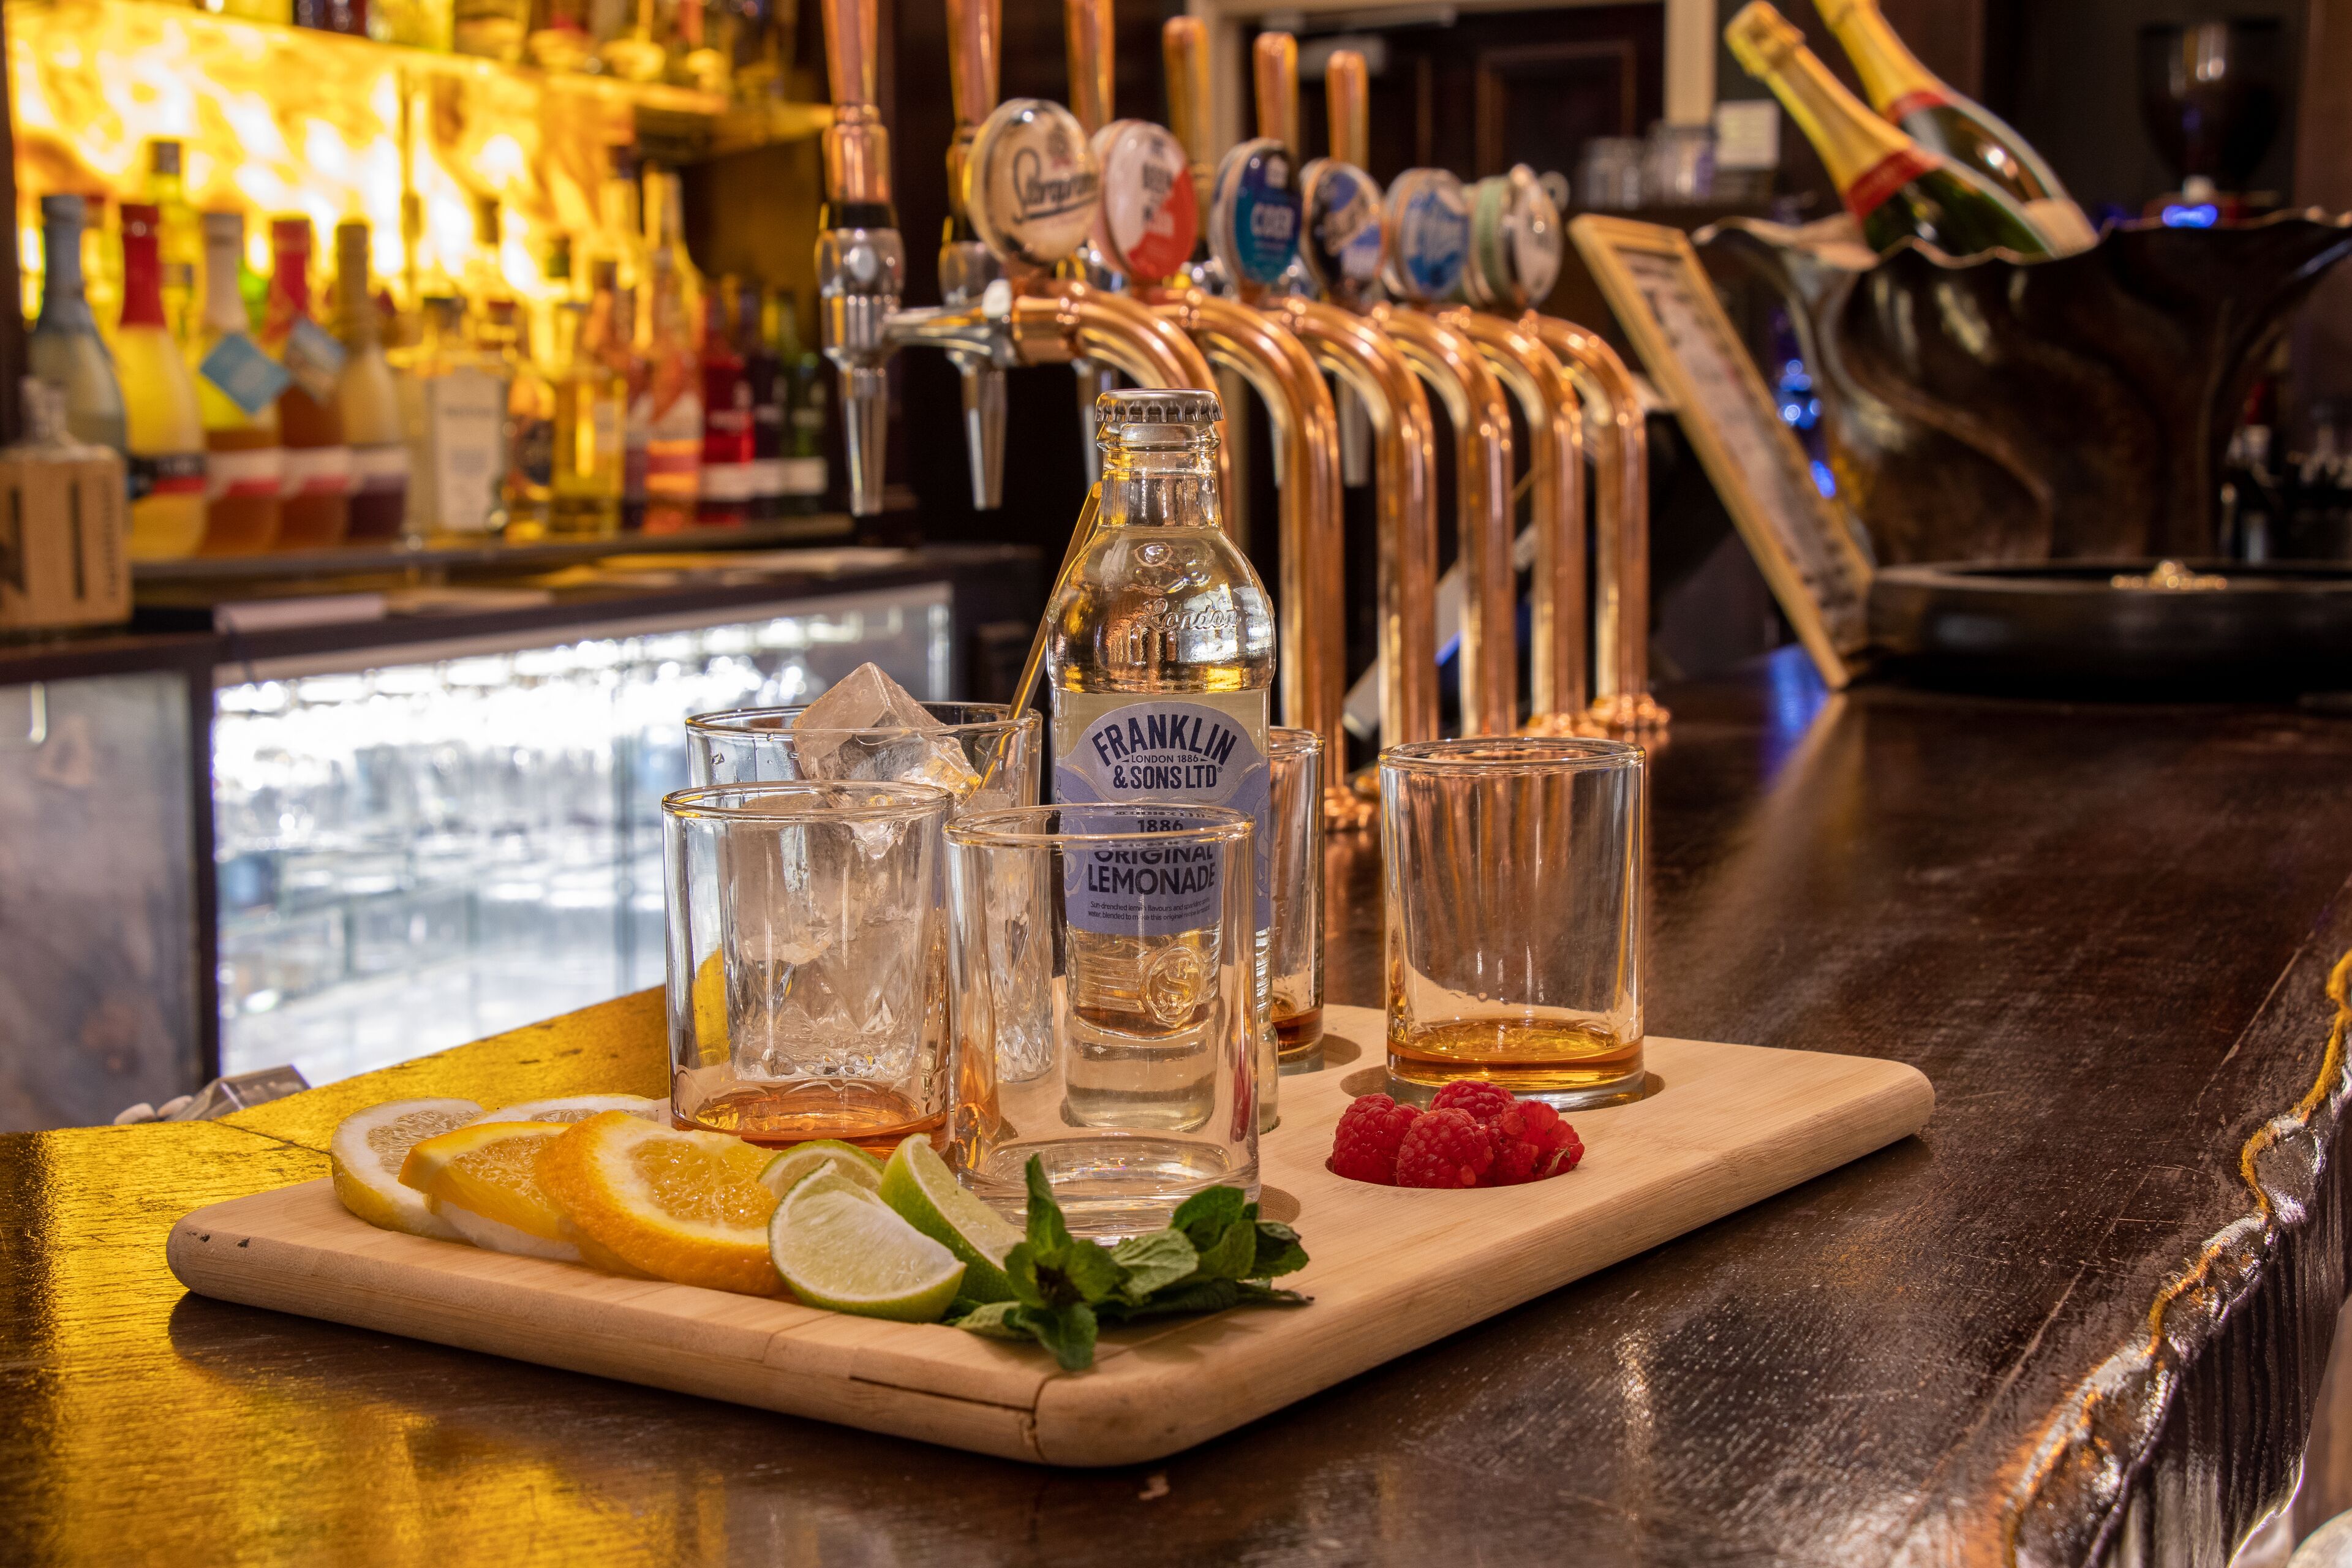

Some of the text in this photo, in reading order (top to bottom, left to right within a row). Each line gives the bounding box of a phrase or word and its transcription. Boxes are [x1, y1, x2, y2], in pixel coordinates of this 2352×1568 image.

[1091, 714, 1237, 767] FRANKLIN
[1131, 754, 1199, 763] LONDON 1886
[1113, 764, 1128, 789] &
[1130, 766, 1182, 790] SONS
[1137, 819, 1184, 833] 1886
[1094, 845, 1213, 865] ORIGINAL
[1088, 862, 1216, 895] LEMONADE
[1163, 913, 1183, 921] original
